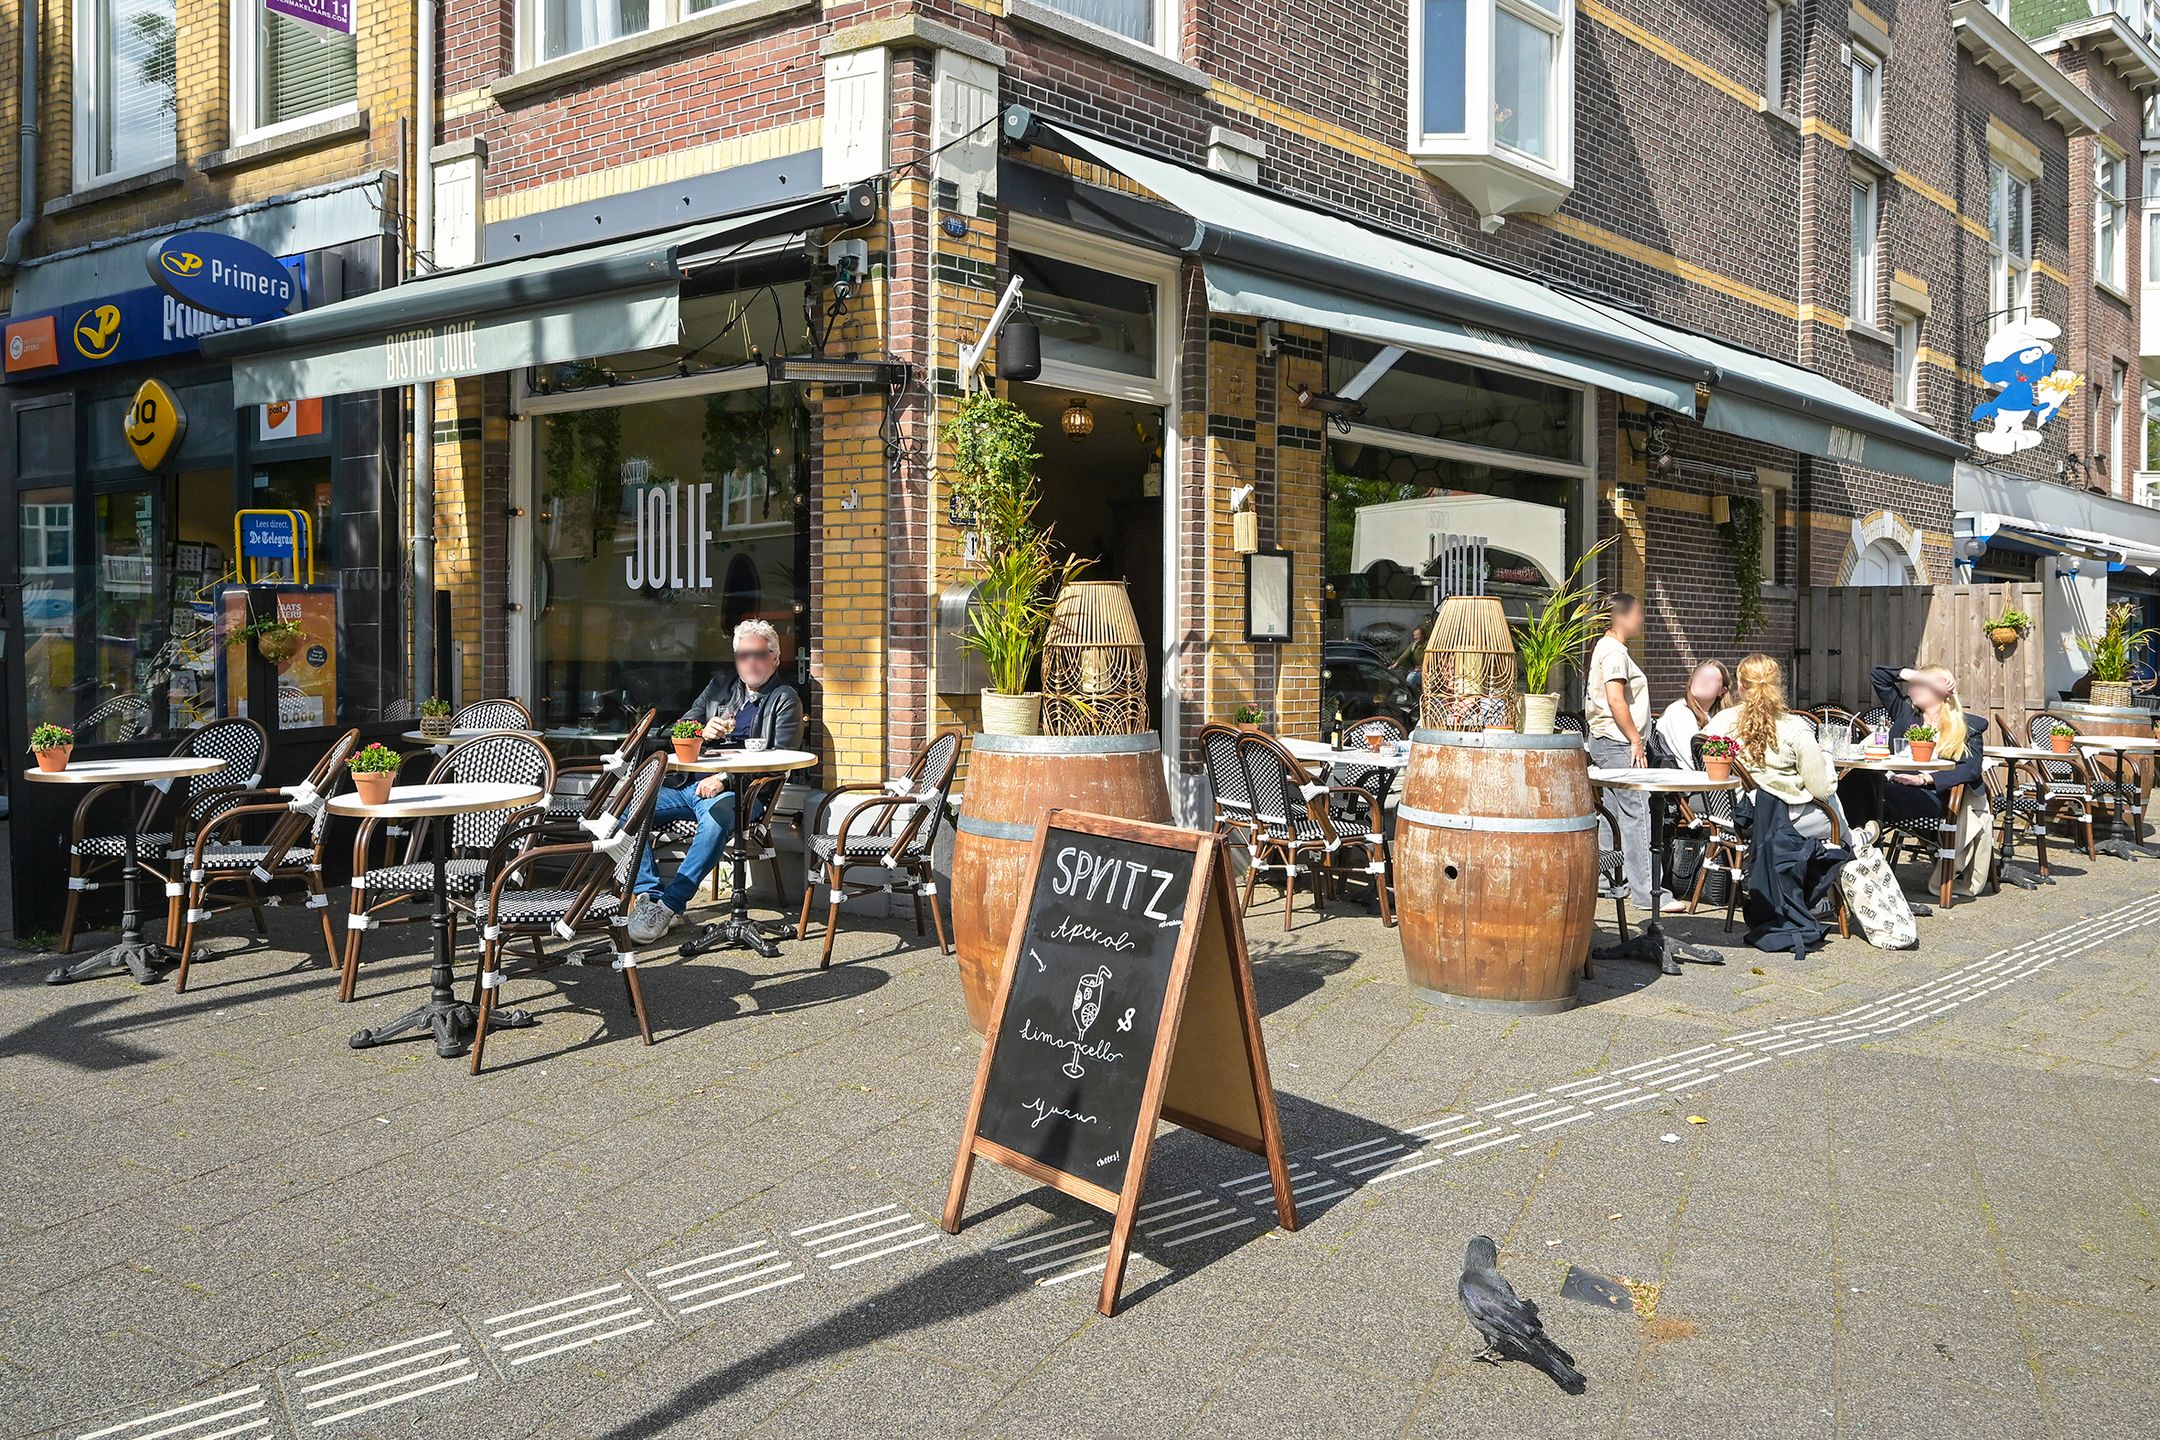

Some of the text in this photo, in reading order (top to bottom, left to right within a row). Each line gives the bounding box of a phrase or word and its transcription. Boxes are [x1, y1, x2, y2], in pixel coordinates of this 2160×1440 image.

[332, 0, 348, 18] 11
[212, 258, 290, 300] Primera
[386, 319, 478, 381] BISTRO JOLIE
[1828, 425, 1850, 459] BISTRO
[620, 459, 649, 486] BISTRO
[249, 530, 293, 548] De Telegraa
[255, 519, 269, 528] Lees
[625, 482, 713, 590] JOLIE
[1860, 905, 1877, 920] STACH
[1051, 915, 1135, 951] Aperol
[1019, 1018, 1124, 1062] Limoncello
